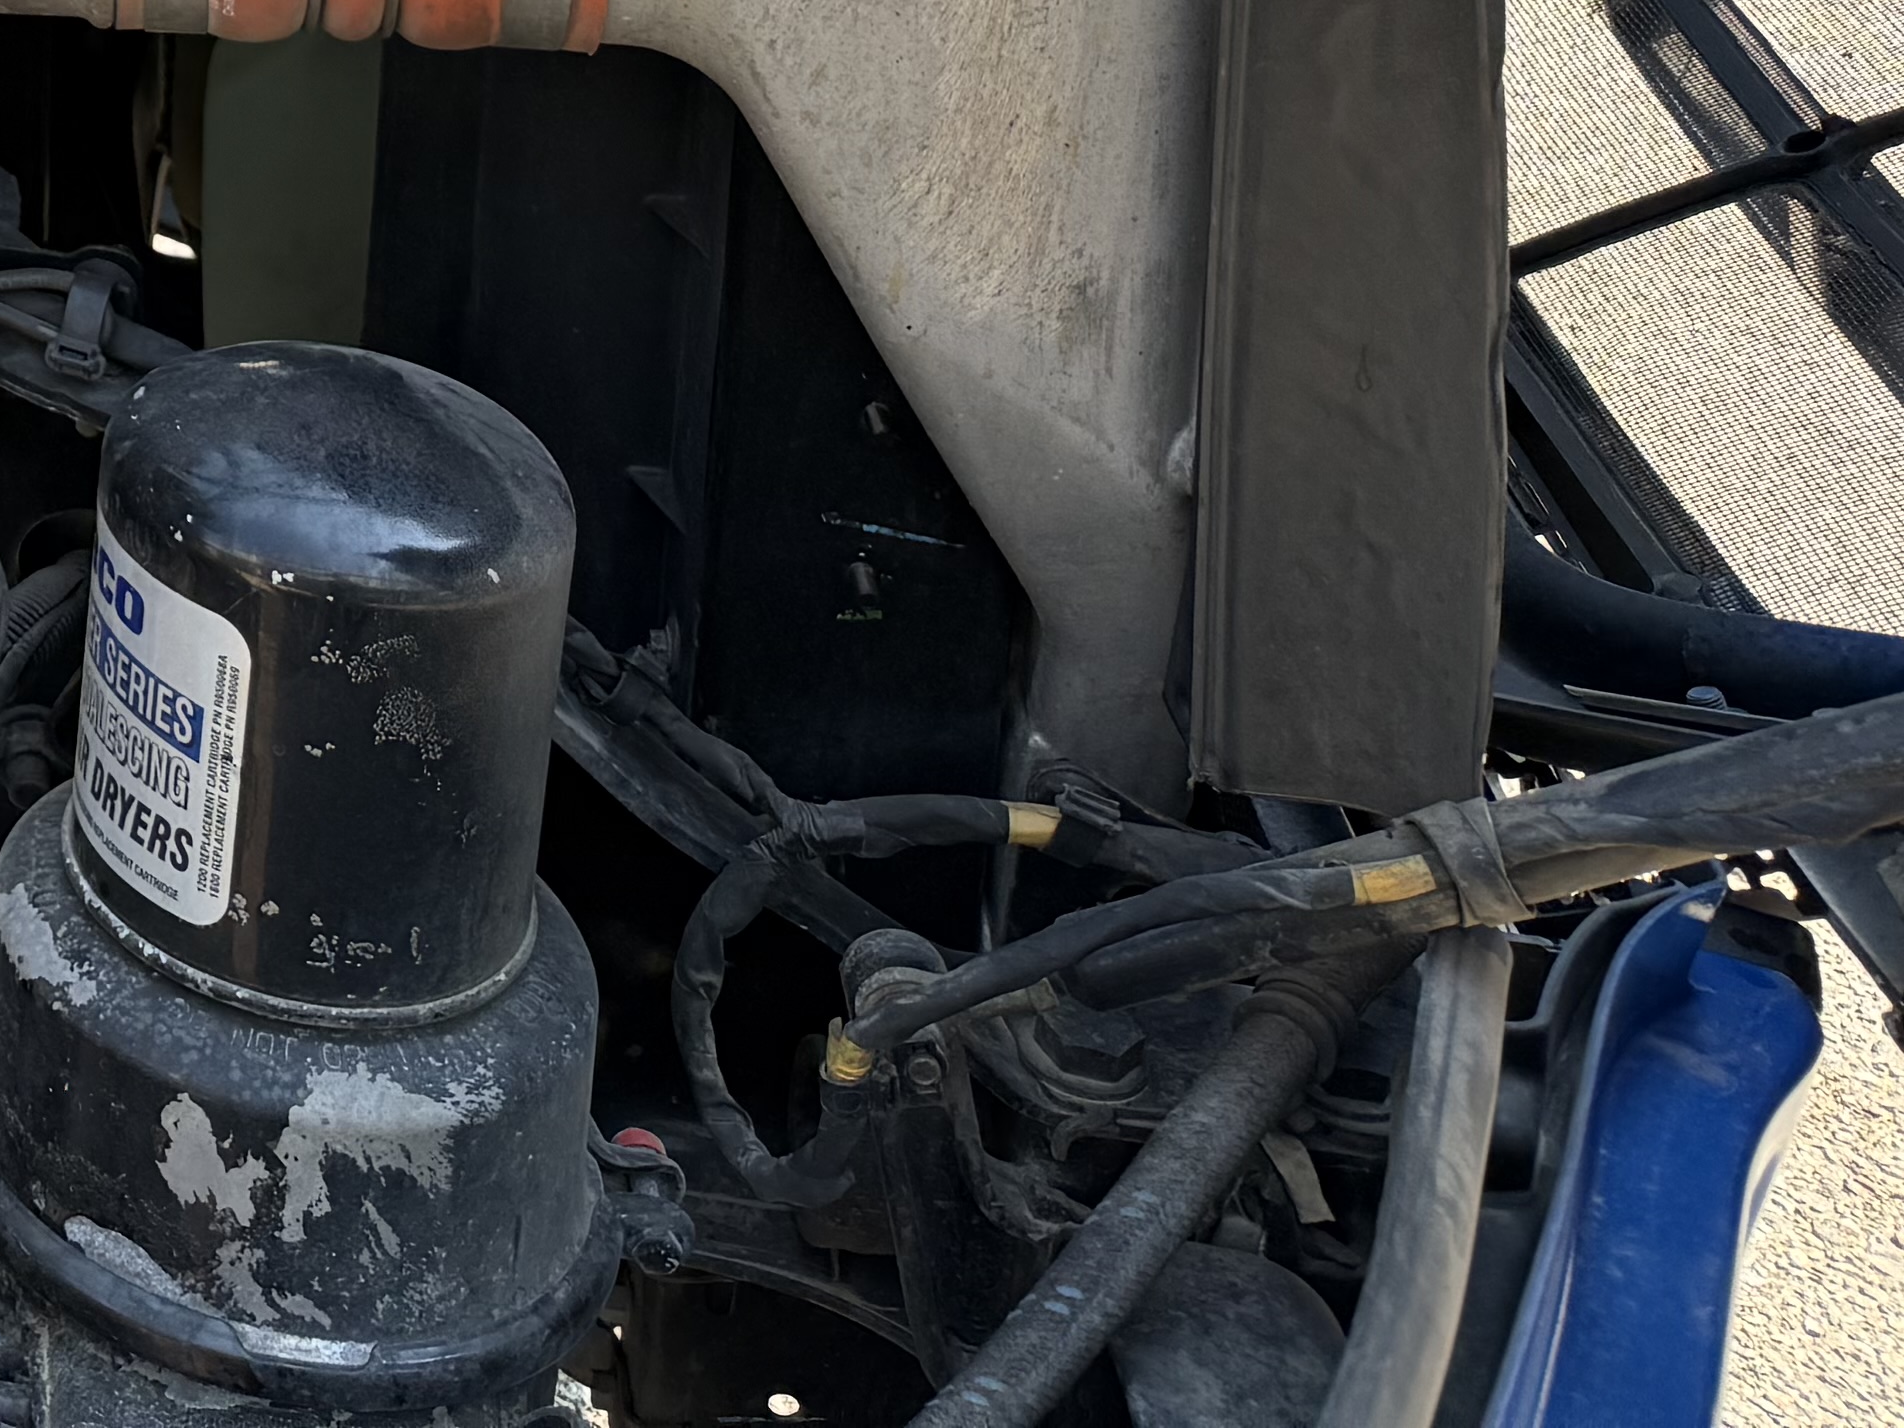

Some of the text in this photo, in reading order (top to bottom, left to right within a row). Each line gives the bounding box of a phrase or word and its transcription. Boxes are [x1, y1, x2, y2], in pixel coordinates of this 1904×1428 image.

[94, 545, 145, 636] CO
[104, 637, 194, 745] SERIES
[212, 710, 223, 727] PN
[206, 727, 222, 788] CARTRIDGE
[211, 794, 229, 872] REPLACEMENT
[224, 715, 237, 731] PN
[91, 754, 194, 873] DRYERS
[199, 788, 216, 867] REPLACEMENT
[92, 821, 180, 902] REPLACEMENT CARTRIDGE
[197, 867, 209, 893] 1200
